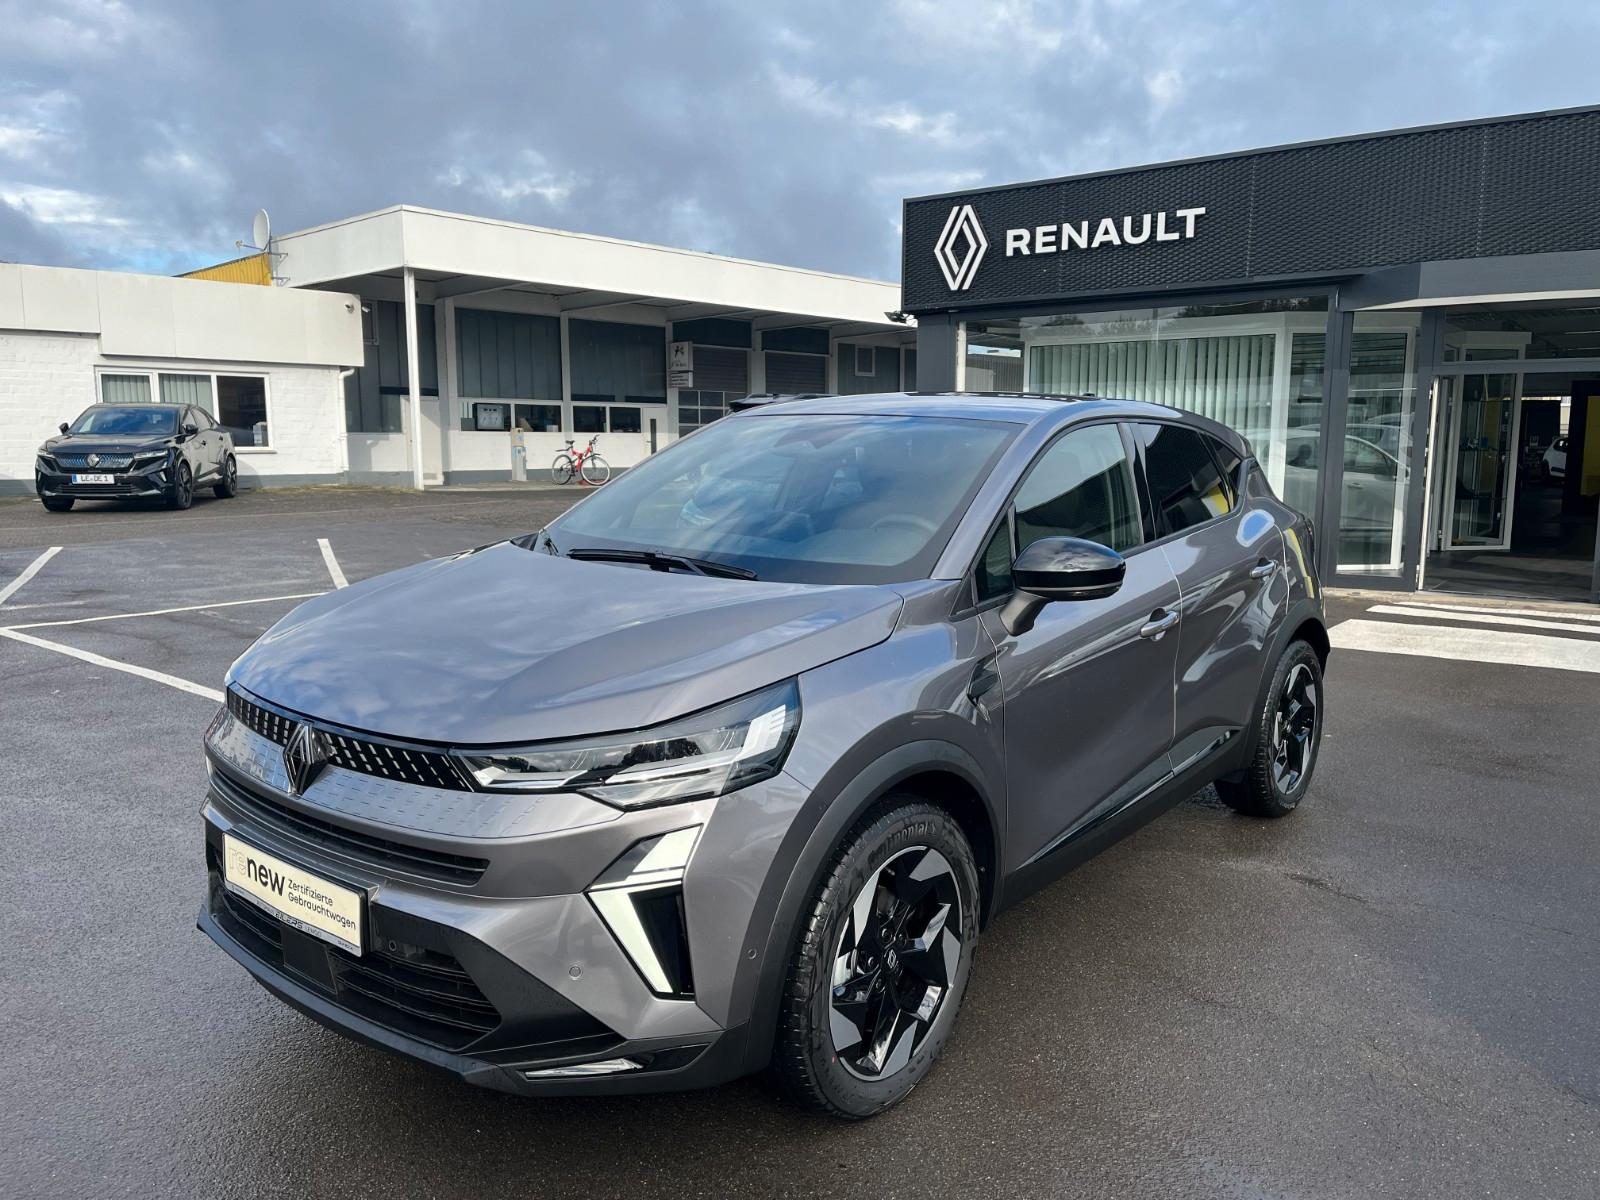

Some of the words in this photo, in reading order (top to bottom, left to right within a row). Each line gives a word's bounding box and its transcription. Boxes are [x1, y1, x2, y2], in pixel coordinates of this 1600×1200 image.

[1006, 207, 1206, 257] RENAULT
[288, 878, 333, 907] Zertifizierte
[288, 892, 356, 930] Gebrauchtwagen
